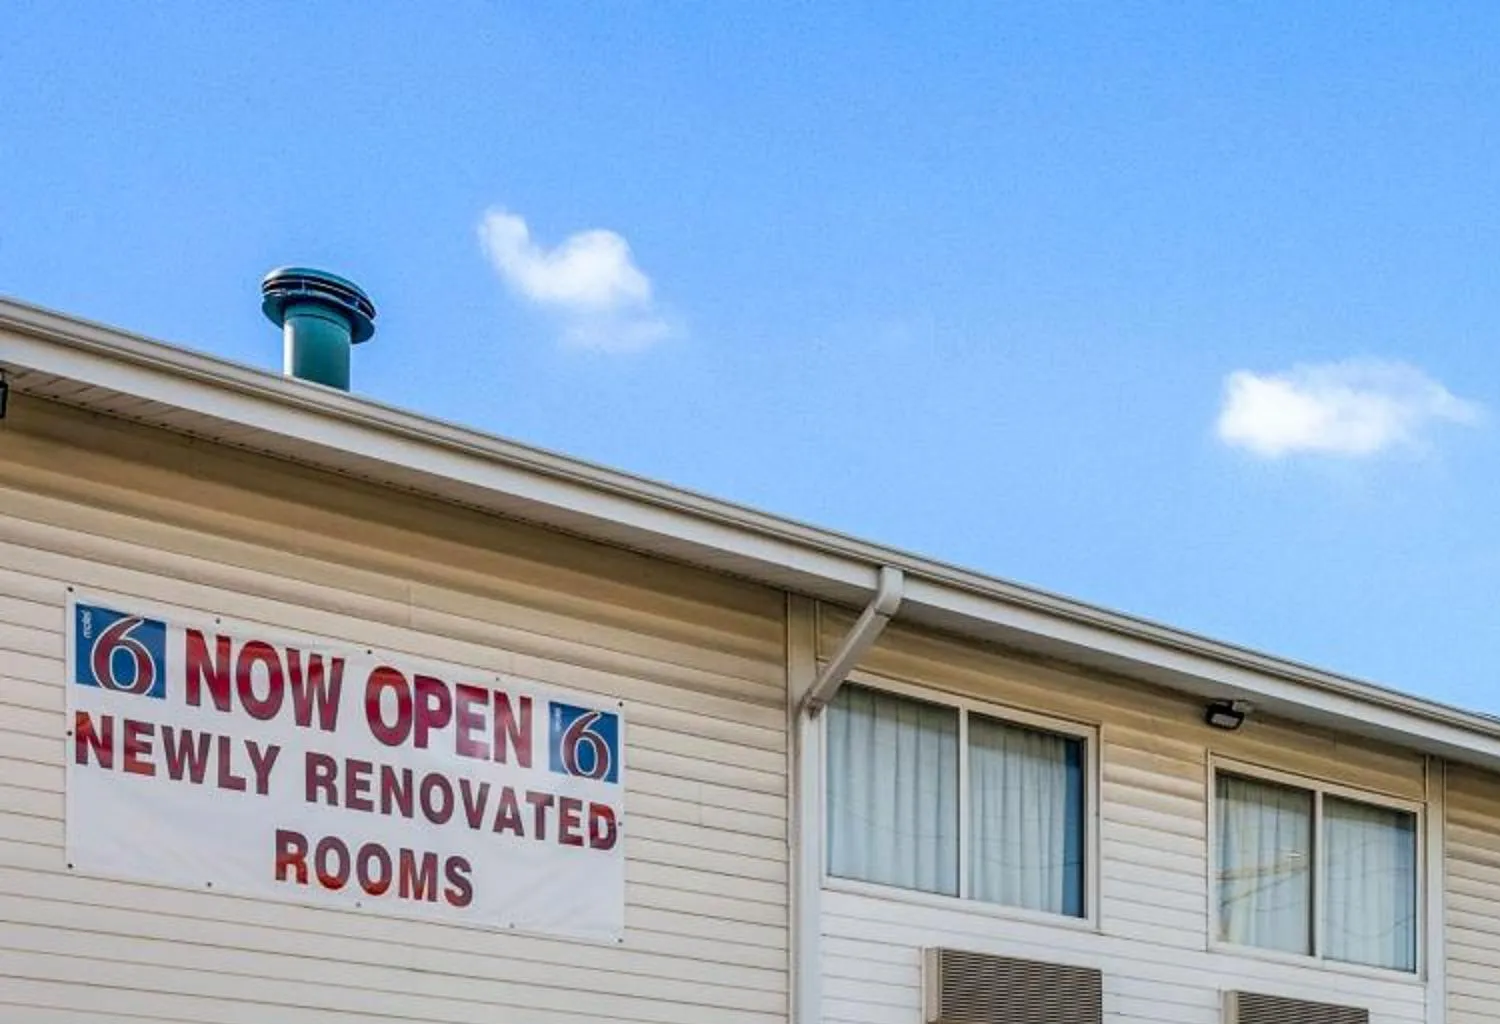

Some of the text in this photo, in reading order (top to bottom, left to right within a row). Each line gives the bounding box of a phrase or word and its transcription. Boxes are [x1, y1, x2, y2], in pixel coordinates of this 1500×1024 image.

[91, 615, 156, 695] 6
[185, 628, 533, 769] NOW OPEN
[75, 711, 619, 851] NEWLY RENOVATED
[562, 711, 611, 780] 6
[275, 829, 473, 908] ROOMS
